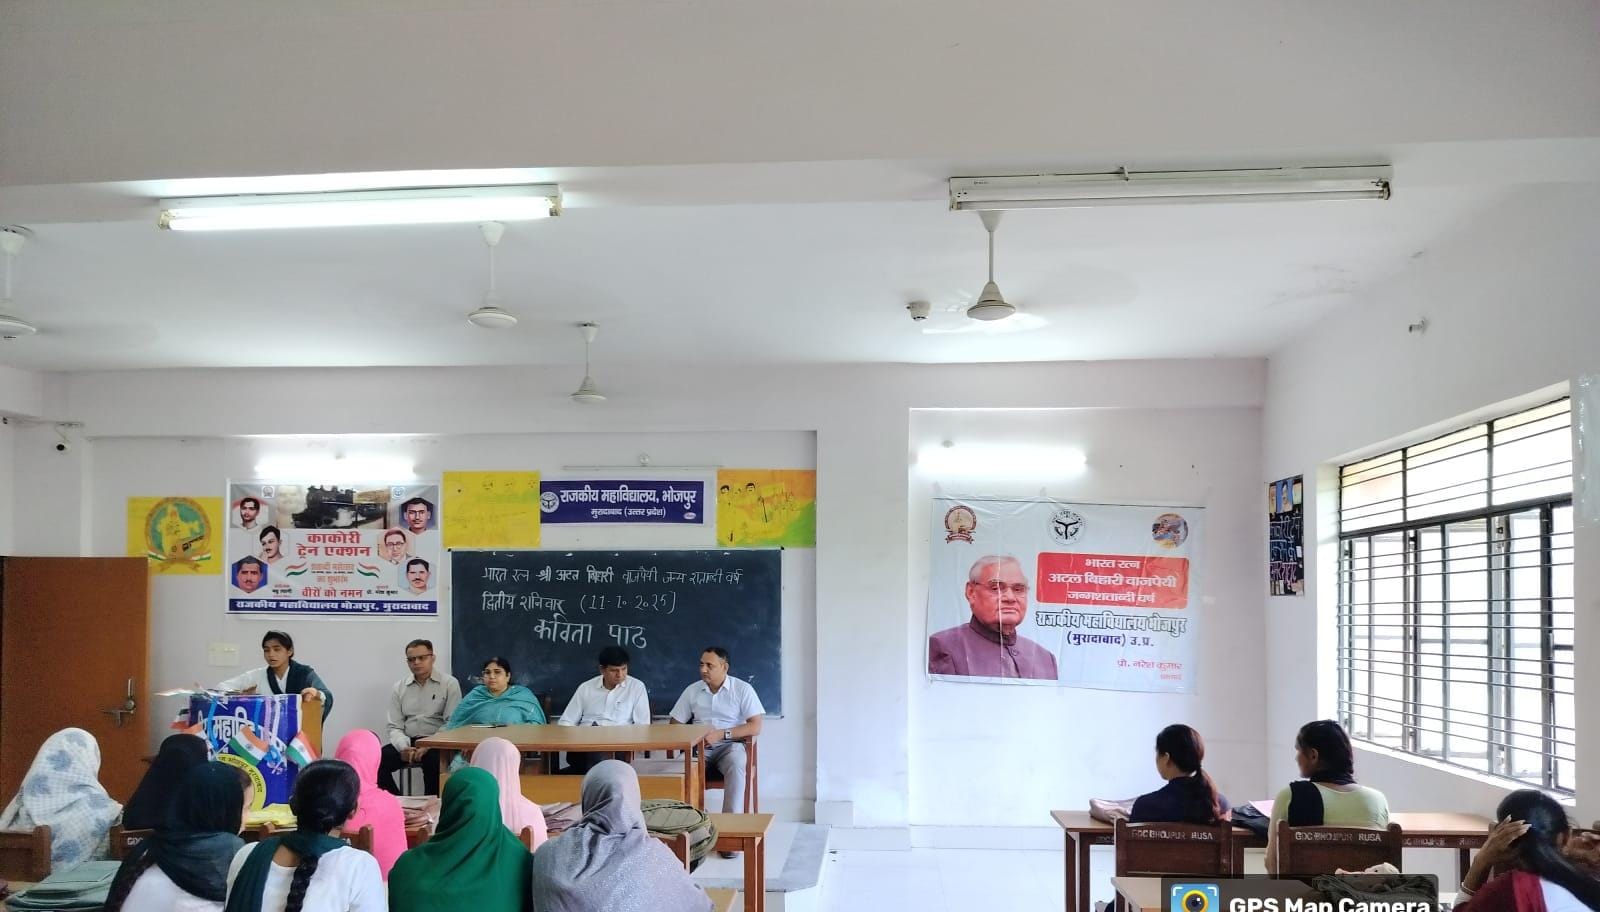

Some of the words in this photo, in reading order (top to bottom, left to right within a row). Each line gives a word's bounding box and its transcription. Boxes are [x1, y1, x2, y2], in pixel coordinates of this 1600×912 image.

[560, 484, 599, 503] राजकीय
[601, 484, 660, 504] महाविद्यालय,
[662, 485, 697, 510] भोजपुर
[591, 508, 622, 519] मुरादाबाद
[624, 507, 645, 518] (उत्तर
[646, 506, 666, 518] प्रदेश)
[307, 530, 361, 545] काकोरी
[296, 543, 319, 559] ट्रेन
[324, 546, 371, 557] एक्शन
[1085, 558, 1116, 569] भारत
[1117, 559, 1140, 569] रत्न
[481, 567, 509, 583] भारत
[512, 568, 530, 583] रत्न
[535, 565, 552, 582] श्री
[556, 569, 580, 582] अटल
[586, 564, 614, 584] बिहारी
[662, 571, 687, 584] जन्म
[725, 568, 744, 585] वर्ष
[1048, 573, 1083, 584] अटल
[1084, 571, 1124, 586] बिहारी
[1126, 574, 1177, 588] वाजपेयी
[302, 586, 322, 598] वीरों
[324, 586, 337, 598] को
[340, 588, 363, 598] नमन
[1137, 592, 1156, 603] वर्ष
[235, 600, 276, 609] राजकीय
[340, 600, 379, 612] भोजपुर,
[382, 602, 430, 612] मुरादाबाद
[481, 590, 518, 612] द्वितीय
[519, 591, 567, 615] शनिवार
[1036, 609, 1081, 628] राजकीय
[1082, 609, 1148, 632] महाविद्यालय
[1147, 612, 1188, 637] भोजपुर
[533, 613, 593, 645] कविता
[608, 624, 648, 649] पाठ
[1066, 630, 1127, 647] (मुरादाबाद)
[1130, 636, 1155, 647] उ.प्र.
[1117, 658, 1130, 668] प्रो.
[1156, 660, 1184, 671] कुमार
[1191, 831, 1214, 840] RUSA
[1295, 831, 1313, 841] GDC
[1358, 833, 1382, 842] RUSA
